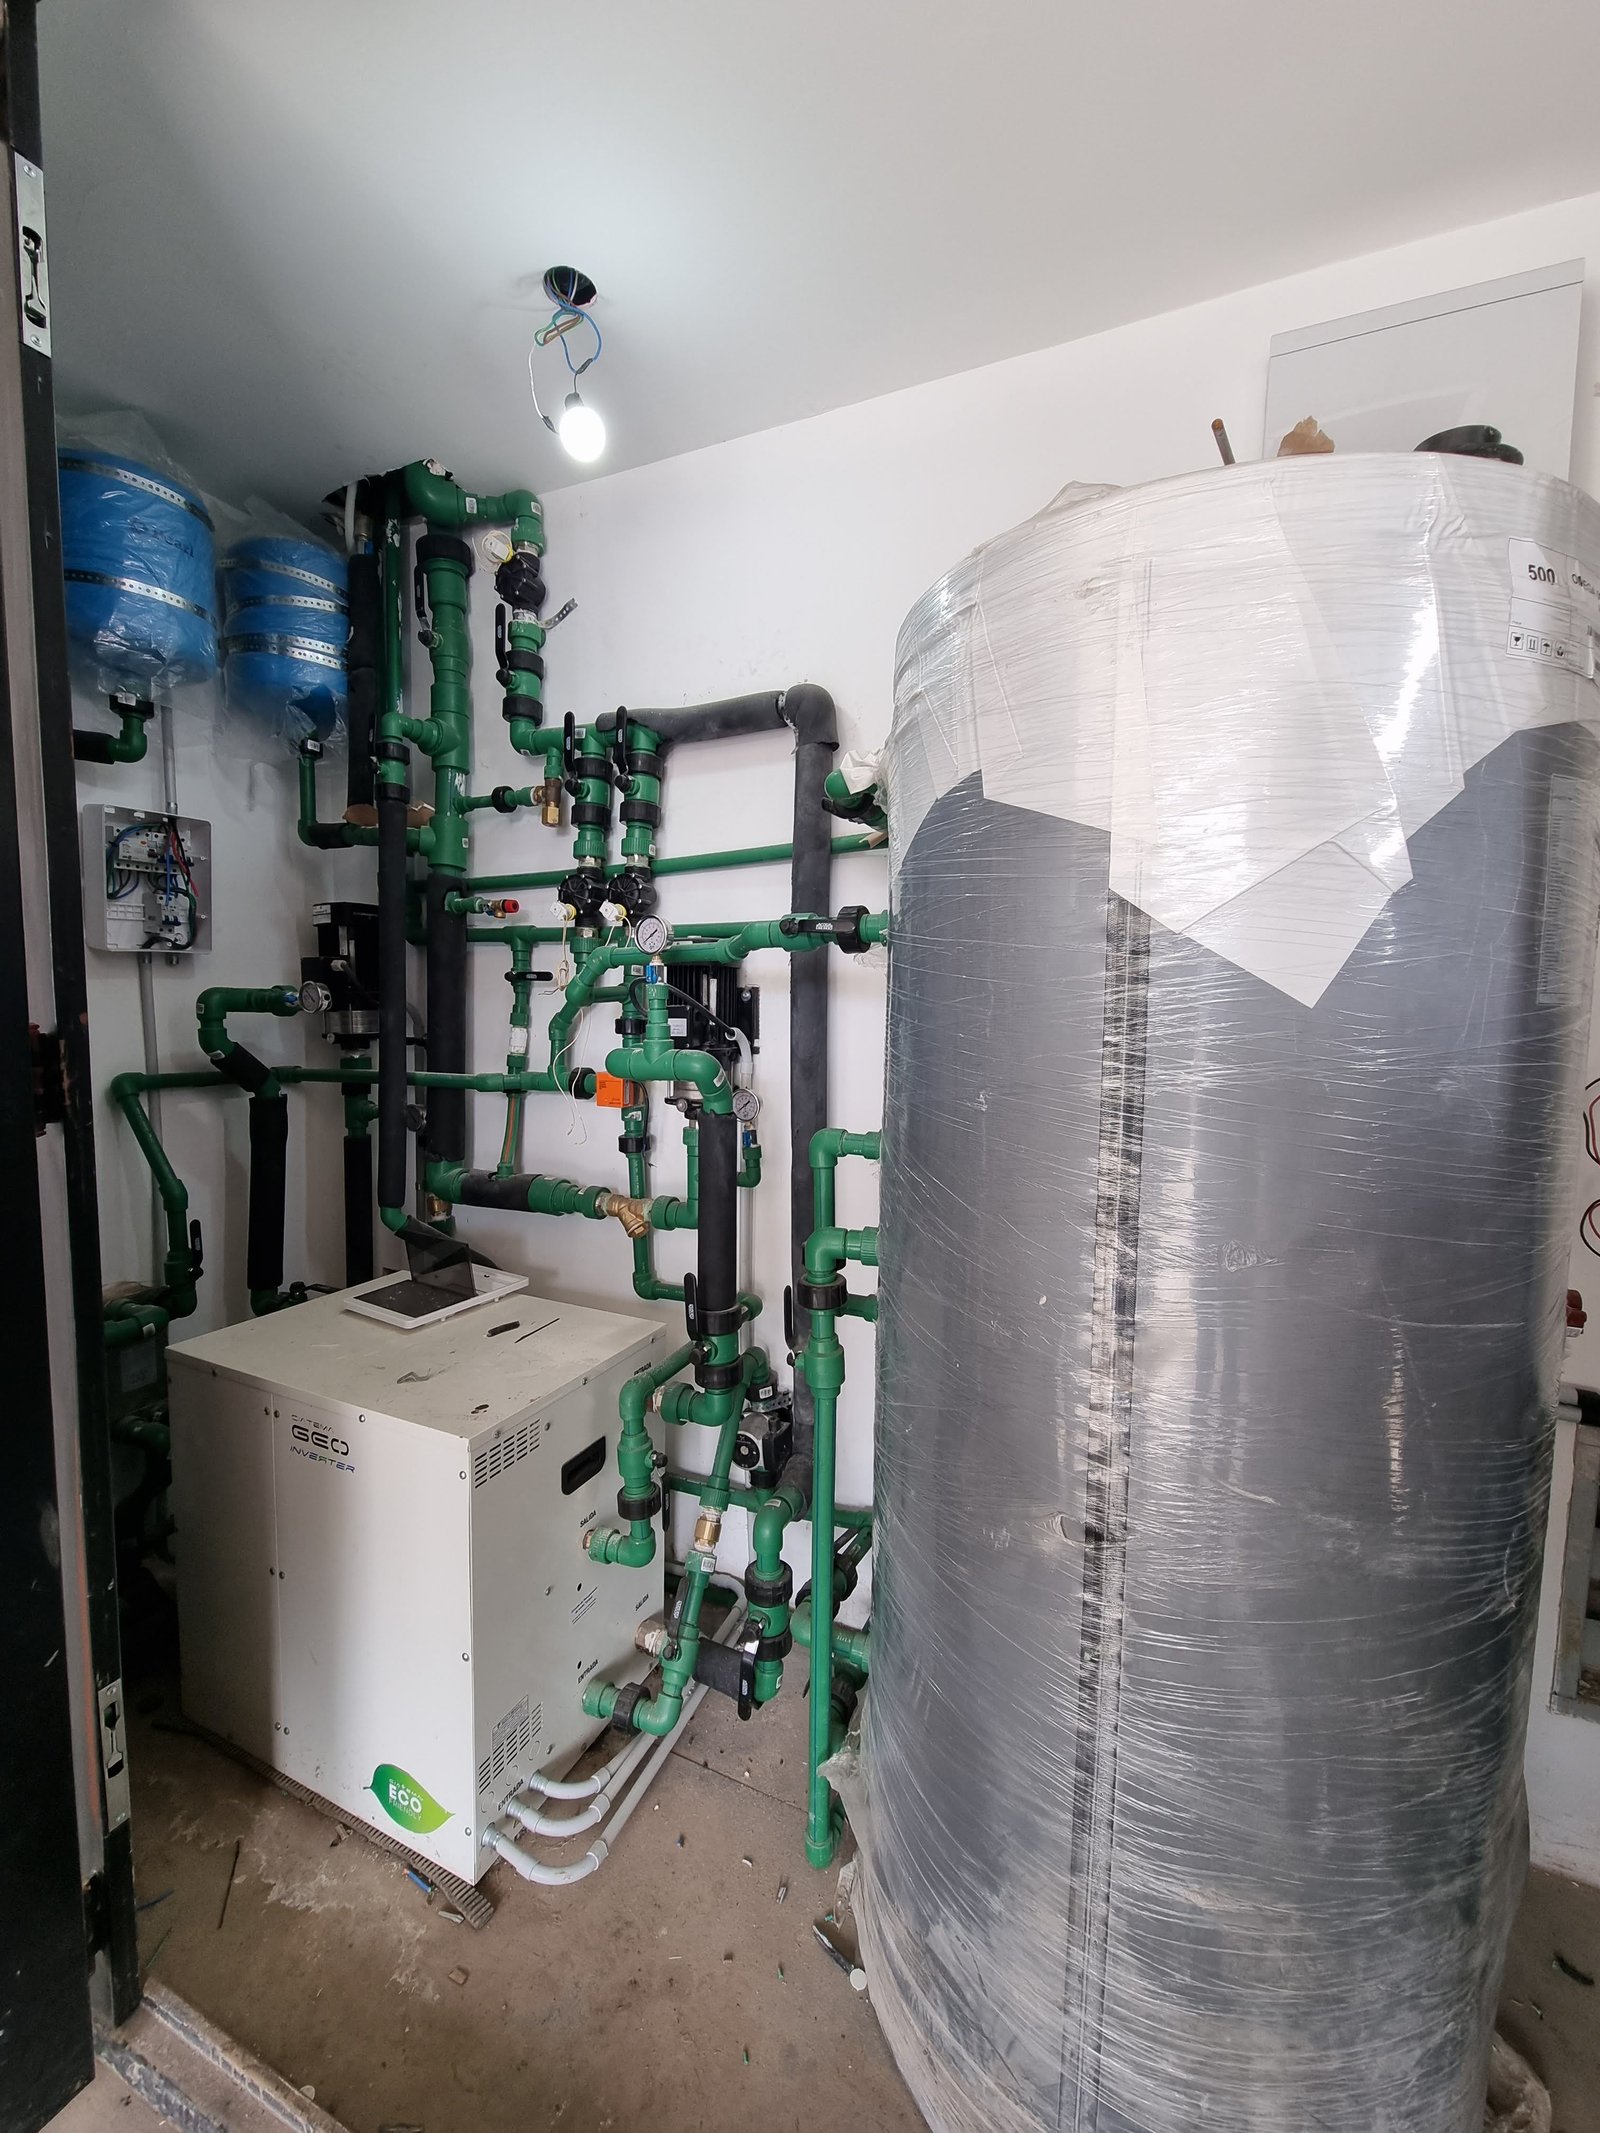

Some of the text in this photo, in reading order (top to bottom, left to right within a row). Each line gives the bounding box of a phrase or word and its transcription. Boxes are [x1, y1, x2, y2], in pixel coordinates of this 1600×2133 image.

[1528, 564, 1556, 585] 500
[292, 1424, 349, 1456] GEO
[290, 1445, 355, 1473] INVERTER
[579, 1509, 597, 1528] SALIDA
[635, 1593, 649, 1611] SALIDA
[577, 1658, 599, 1684] ENTRADA
[389, 1783, 422, 1813] ECO
[497, 1778, 524, 1811] ENTRADA
